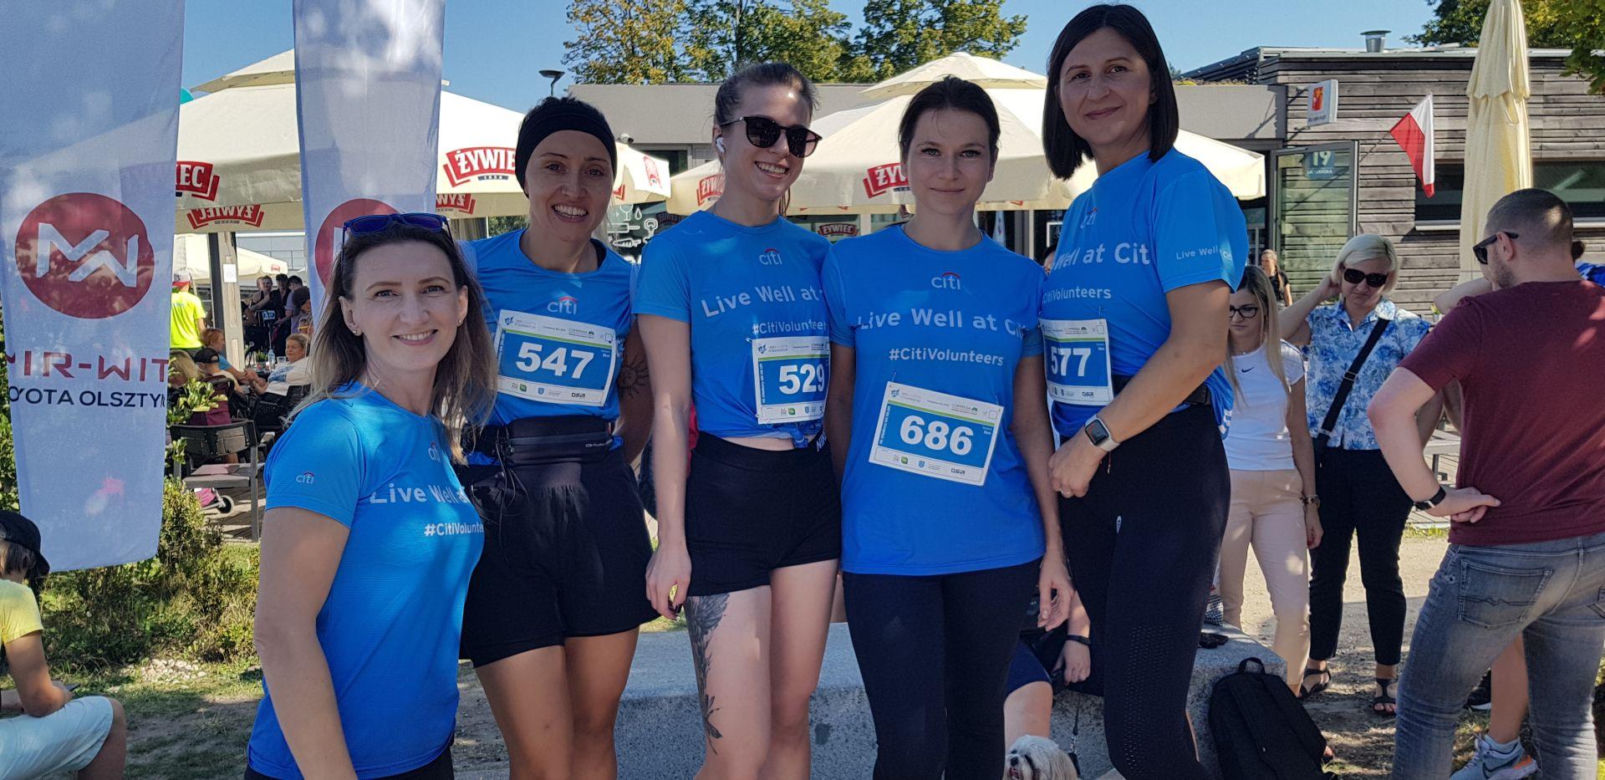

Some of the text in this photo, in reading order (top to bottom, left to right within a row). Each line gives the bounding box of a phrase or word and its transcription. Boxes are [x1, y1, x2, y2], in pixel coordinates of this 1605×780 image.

[1083, 243, 1106, 264] at
[1176, 251, 1197, 261] Live
[931, 275, 961, 290] citi
[546, 299, 577, 315] citi
[701, 285, 818, 318] Live Well at
[857, 312, 901, 330] Live
[911, 308, 963, 328] Well
[972, 313, 998, 332] at
[515, 341, 595, 379] 547
[888, 347, 1004, 366] #CitiVolunteers
[1051, 346, 1092, 377] 577
[778, 363, 825, 395] 529
[900, 415, 974, 456] 686
[369, 483, 428, 504] Live
[428, 484, 457, 503] Well
